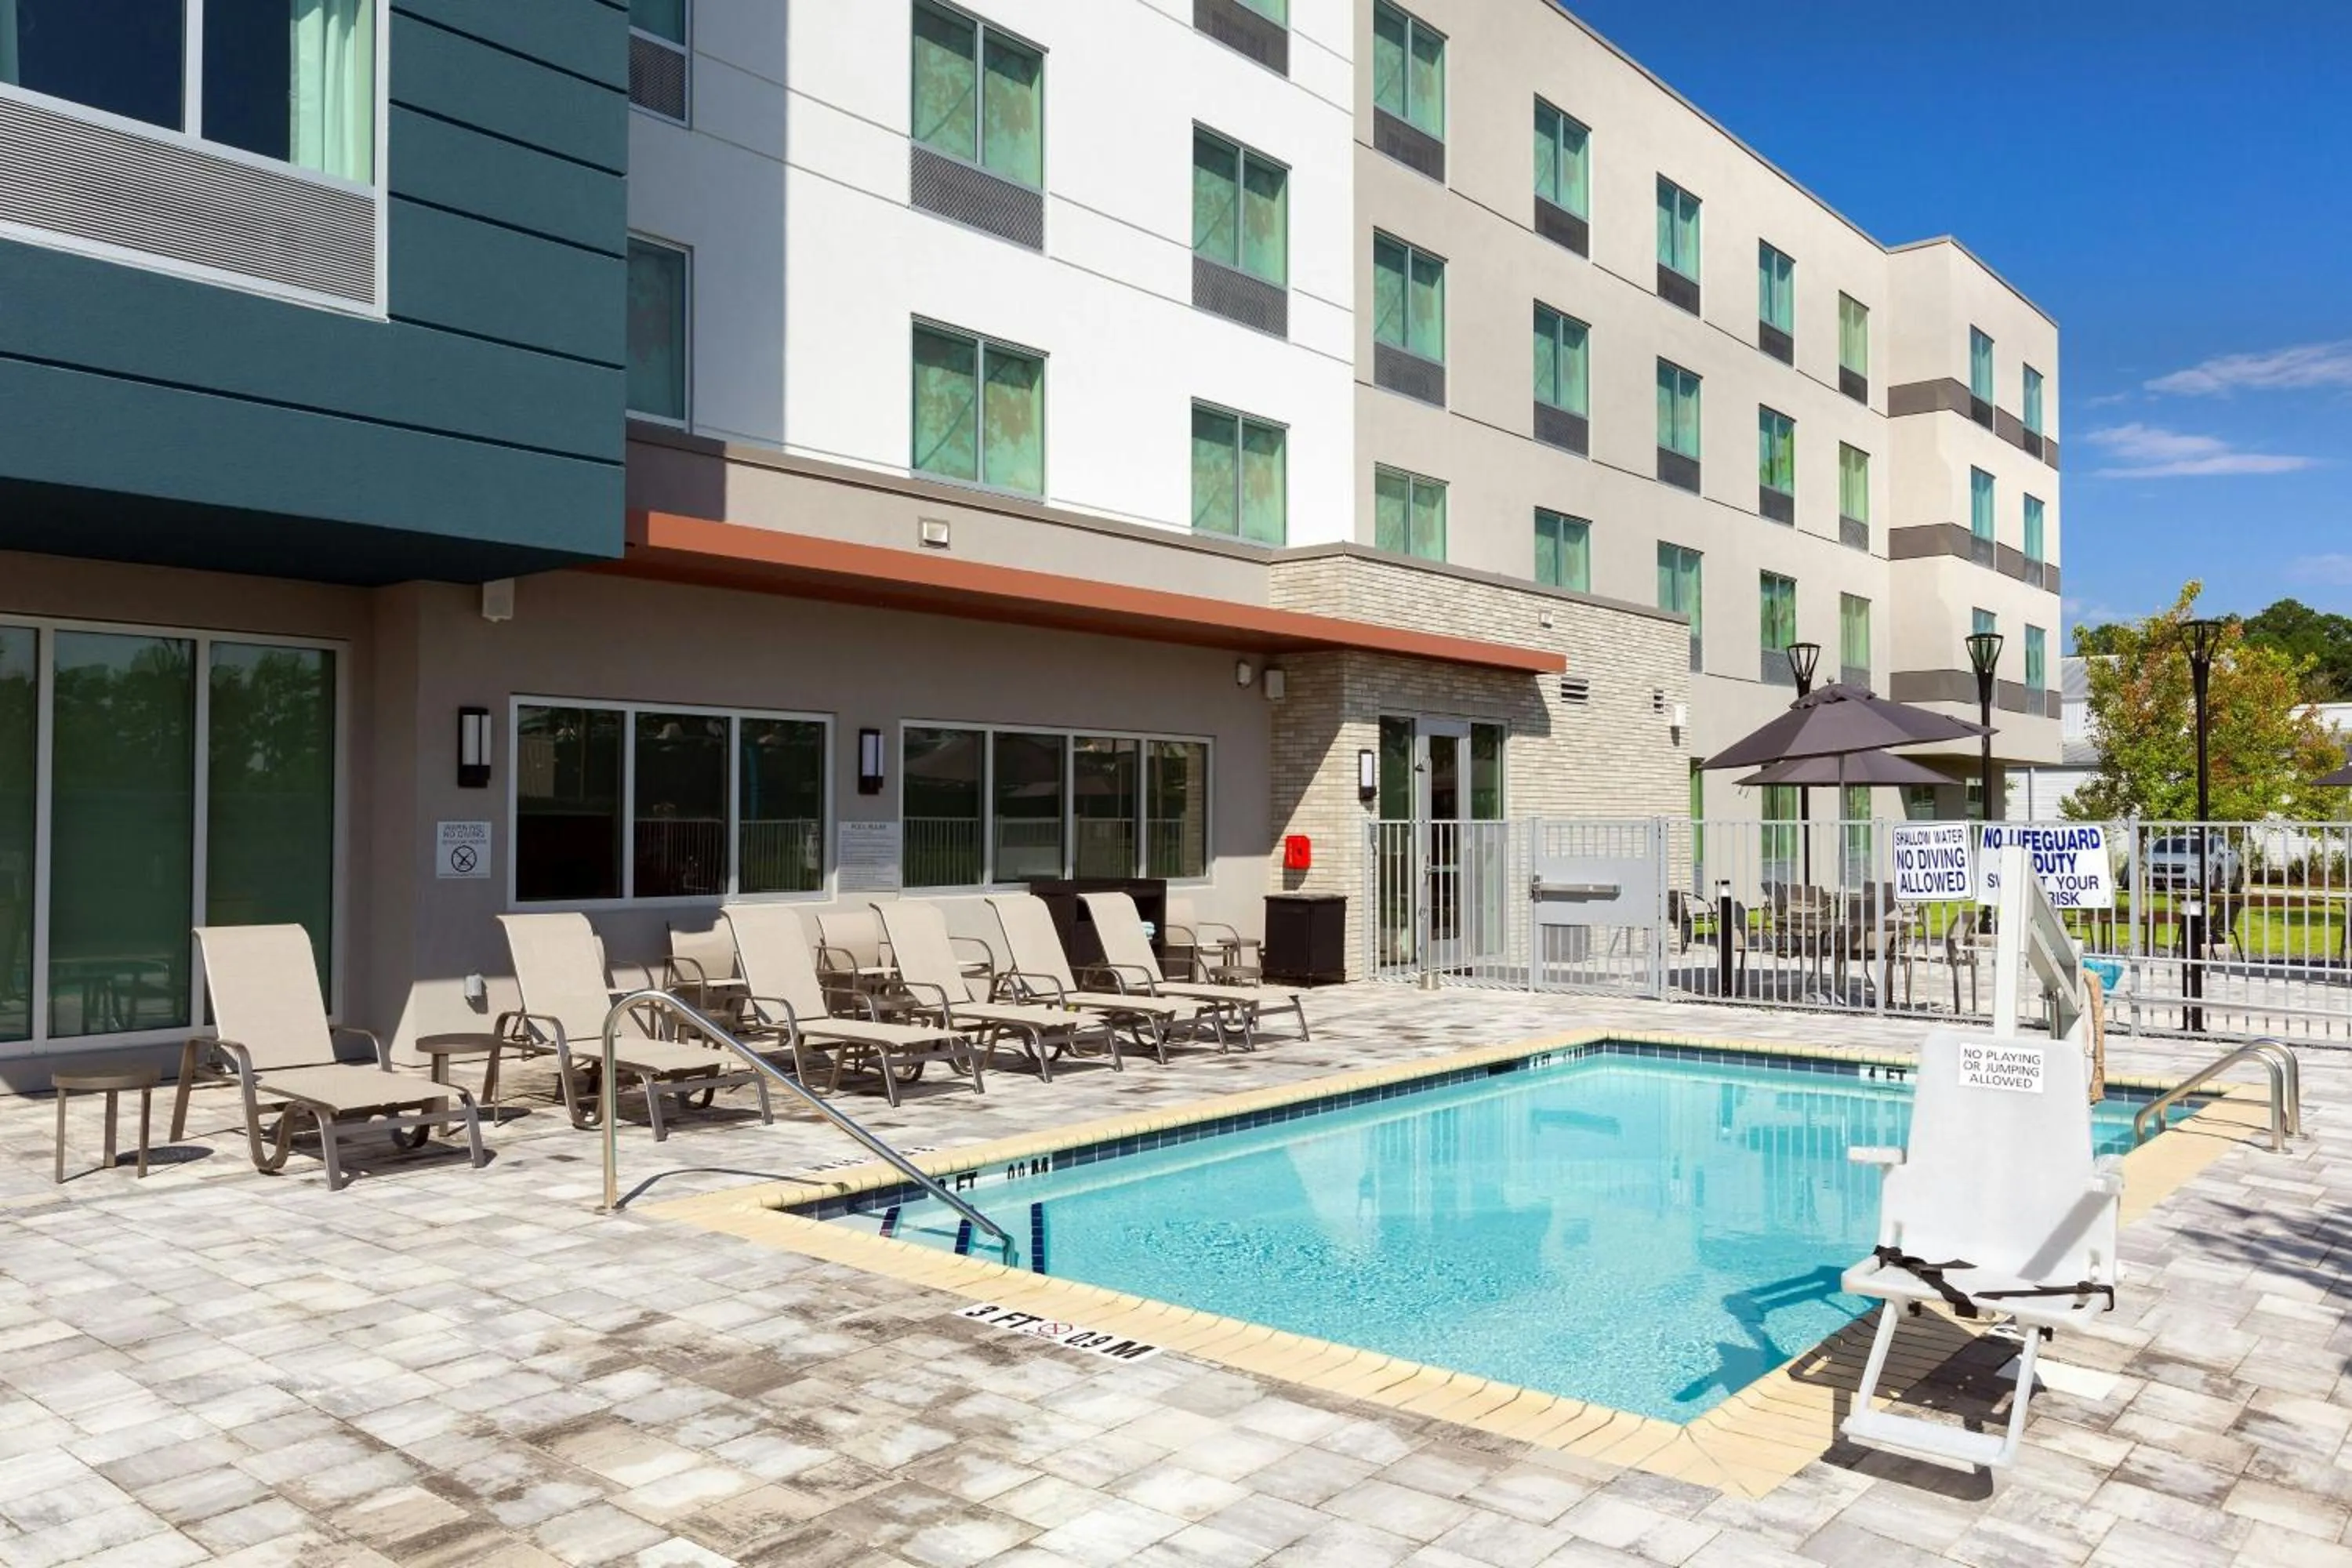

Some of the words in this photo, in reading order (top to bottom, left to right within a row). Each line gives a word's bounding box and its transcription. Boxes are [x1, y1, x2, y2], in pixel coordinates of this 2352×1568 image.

[1896, 831, 1931, 846] SHALLOW
[1933, 829, 1964, 844] WATER
[1984, 828, 2002, 848] NO
[1896, 849, 1914, 870] NO
[1917, 847, 1965, 869] DIVING
[2033, 853, 2077, 874] DUTY
[1900, 871, 1966, 893] ALLOWED
[2056, 876, 2100, 890] YOUR
[1963, 1047, 1983, 1059] NO
[1986, 1050, 2041, 1065] PLAYING
[1886, 1067, 1907, 1081] FT
[1962, 1060, 1981, 1072] OR
[1985, 1062, 2040, 1078] JUMPING
[1969, 1073, 2033, 1089] ALLOWED
[956, 1171, 978, 1192] FT
[965, 1305, 1000, 1317] 3
[989, 1312, 1044, 1329] FT
[1063, 1330, 1112, 1348] 0.9
[1100, 1340, 1156, 1359] M
